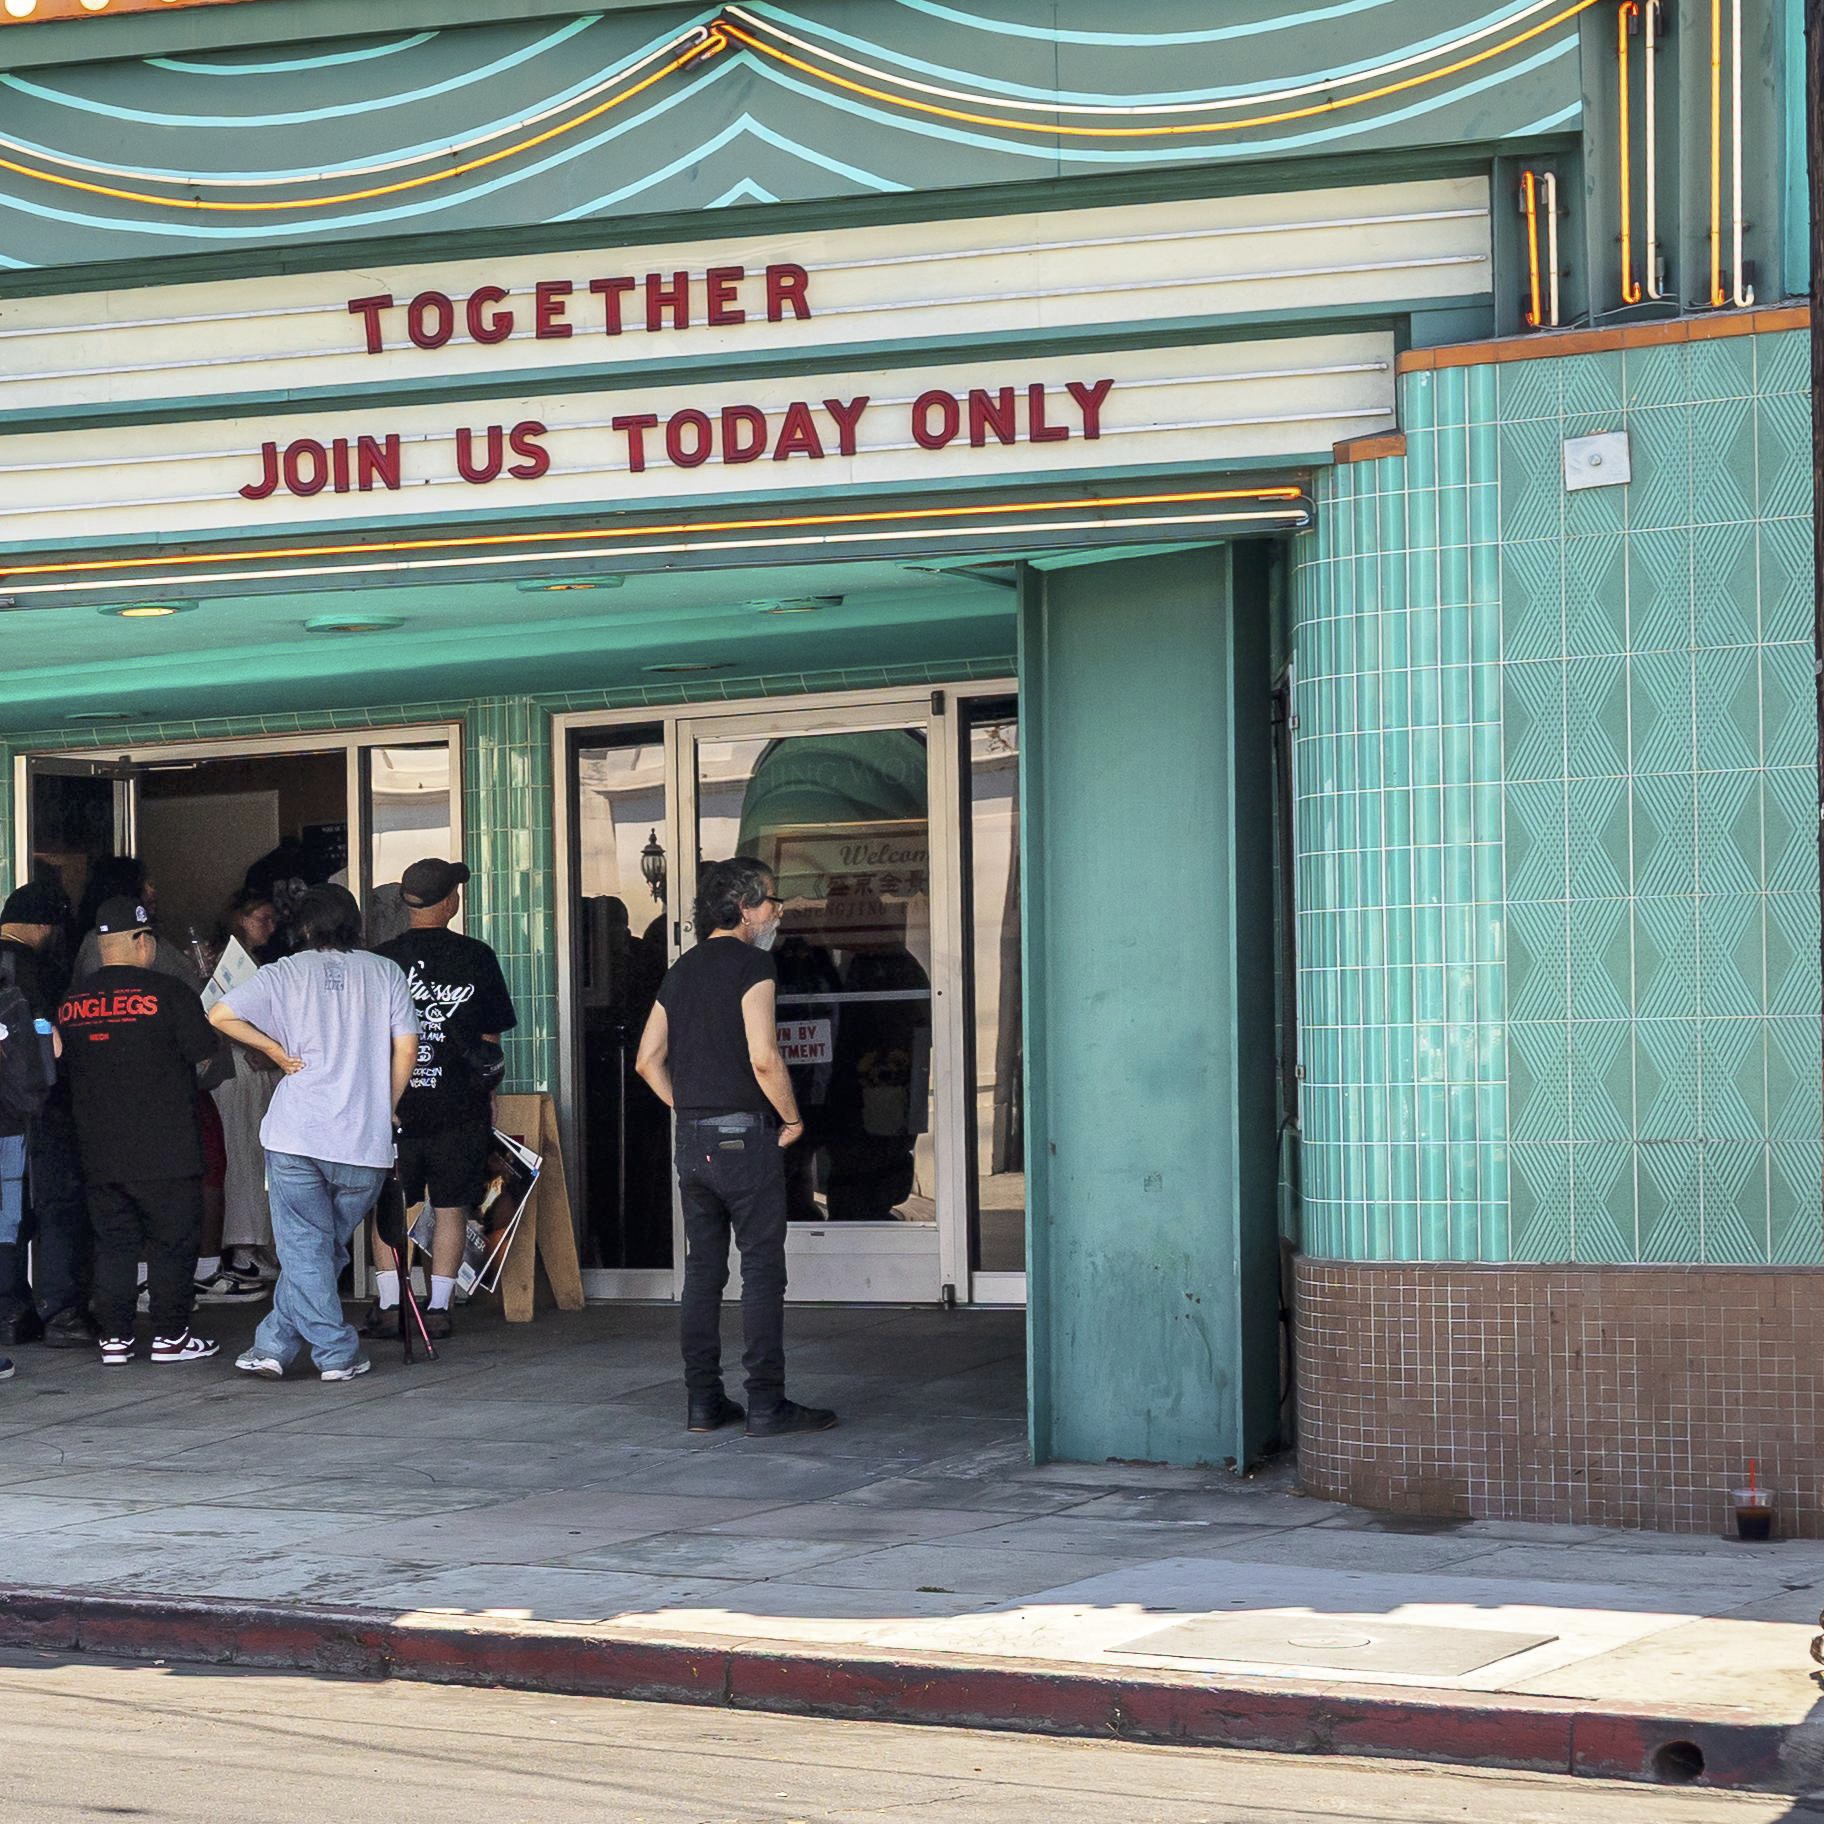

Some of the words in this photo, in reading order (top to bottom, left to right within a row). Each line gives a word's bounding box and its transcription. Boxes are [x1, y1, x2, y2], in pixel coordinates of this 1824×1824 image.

[346, 263, 813, 354] TOGETHER
[238, 433, 402, 500] JOIN
[455, 419, 551, 484] US
[612, 395, 870, 473] TODAY
[910, 378, 1115, 450] ONLY
[799, 1026, 817, 1041] BY
